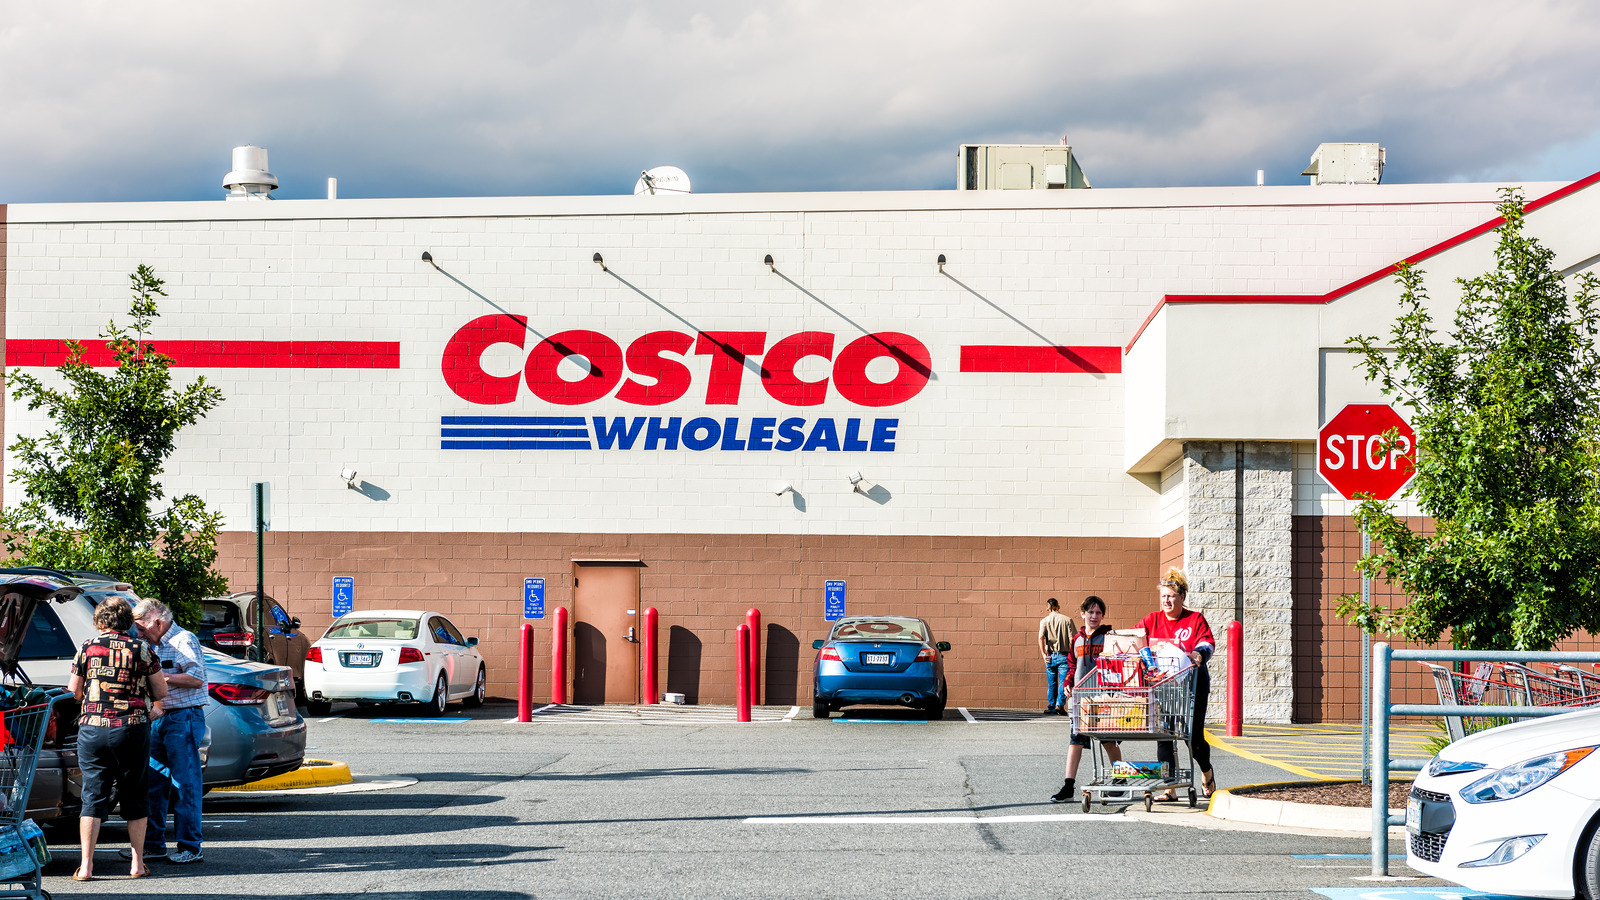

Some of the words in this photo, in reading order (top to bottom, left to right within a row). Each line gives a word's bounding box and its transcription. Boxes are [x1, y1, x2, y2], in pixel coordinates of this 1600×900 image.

[441, 313, 932, 407] COSTCO
[592, 416, 899, 452] WHOLESALE
[1325, 434, 1411, 471] STOP
